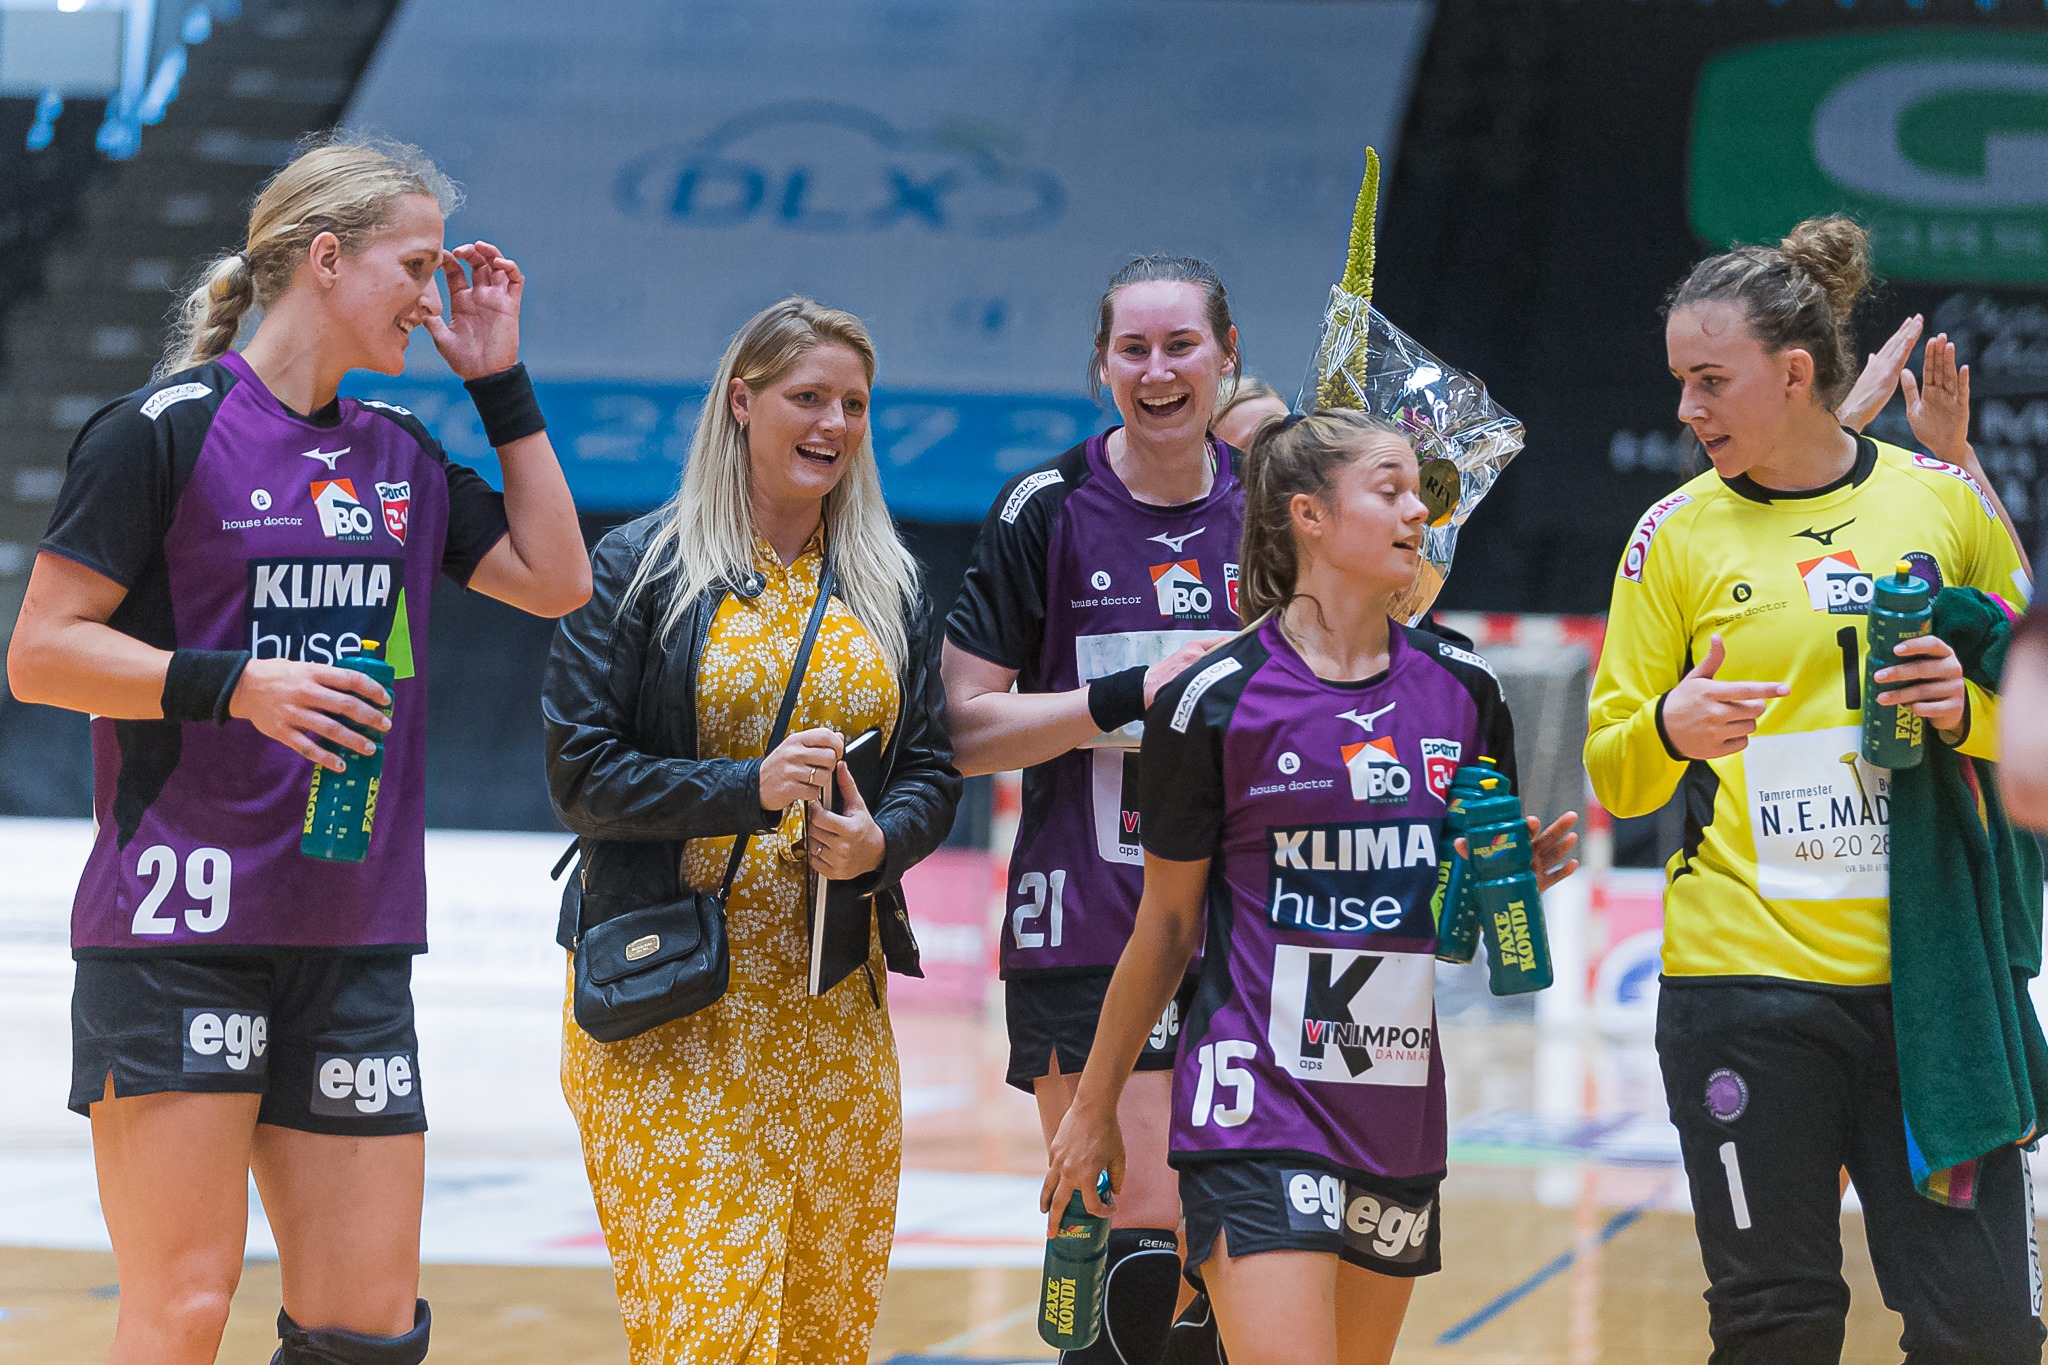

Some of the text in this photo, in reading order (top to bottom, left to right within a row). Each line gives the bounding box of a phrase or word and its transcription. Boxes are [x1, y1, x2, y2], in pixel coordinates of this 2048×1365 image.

[378, 484, 410, 500] SPORT
[221, 515, 303, 530] house doctor
[334, 506, 374, 535] BO
[253, 563, 391, 608] KLIMA
[1071, 596, 1142, 609] house doctor
[1175, 586, 1213, 614] BO
[1744, 600, 1789, 617] doctor
[1826, 575, 1875, 607] BO
[251, 620, 363, 668] huse
[1423, 742, 1459, 758] SPORT
[361, 775, 383, 833] FAXE
[1250, 778, 1334, 796] house doctor
[1368, 765, 1411, 797] BO
[1758, 784, 1833, 803] Tømrermester
[1118, 846, 1139, 857] aps
[1273, 824, 1437, 871] KLIMA
[1794, 838, 1825, 862] 40
[1832, 834, 1863, 858] 20
[131, 844, 232, 935] 29
[1012, 869, 1066, 950] 21
[1271, 877, 1403, 931] huse
[1494, 910, 1519, 968] FAXE
[1508, 900, 1537, 973] KONDI
[189, 1012, 268, 1071] ege
[1149, 1000, 1179, 1050] ge
[319, 1054, 413, 1114] ege
[1191, 1039, 1258, 1128] 15
[1299, 1058, 1323, 1071] aps
[1289, 1173, 1346, 1231] eg
[1718, 1141, 1752, 1230] 1
[1346, 1195, 1429, 1258] ege
[1045, 1276, 1061, 1326] FAXE
[1057, 1276, 1077, 1337] KONDI
